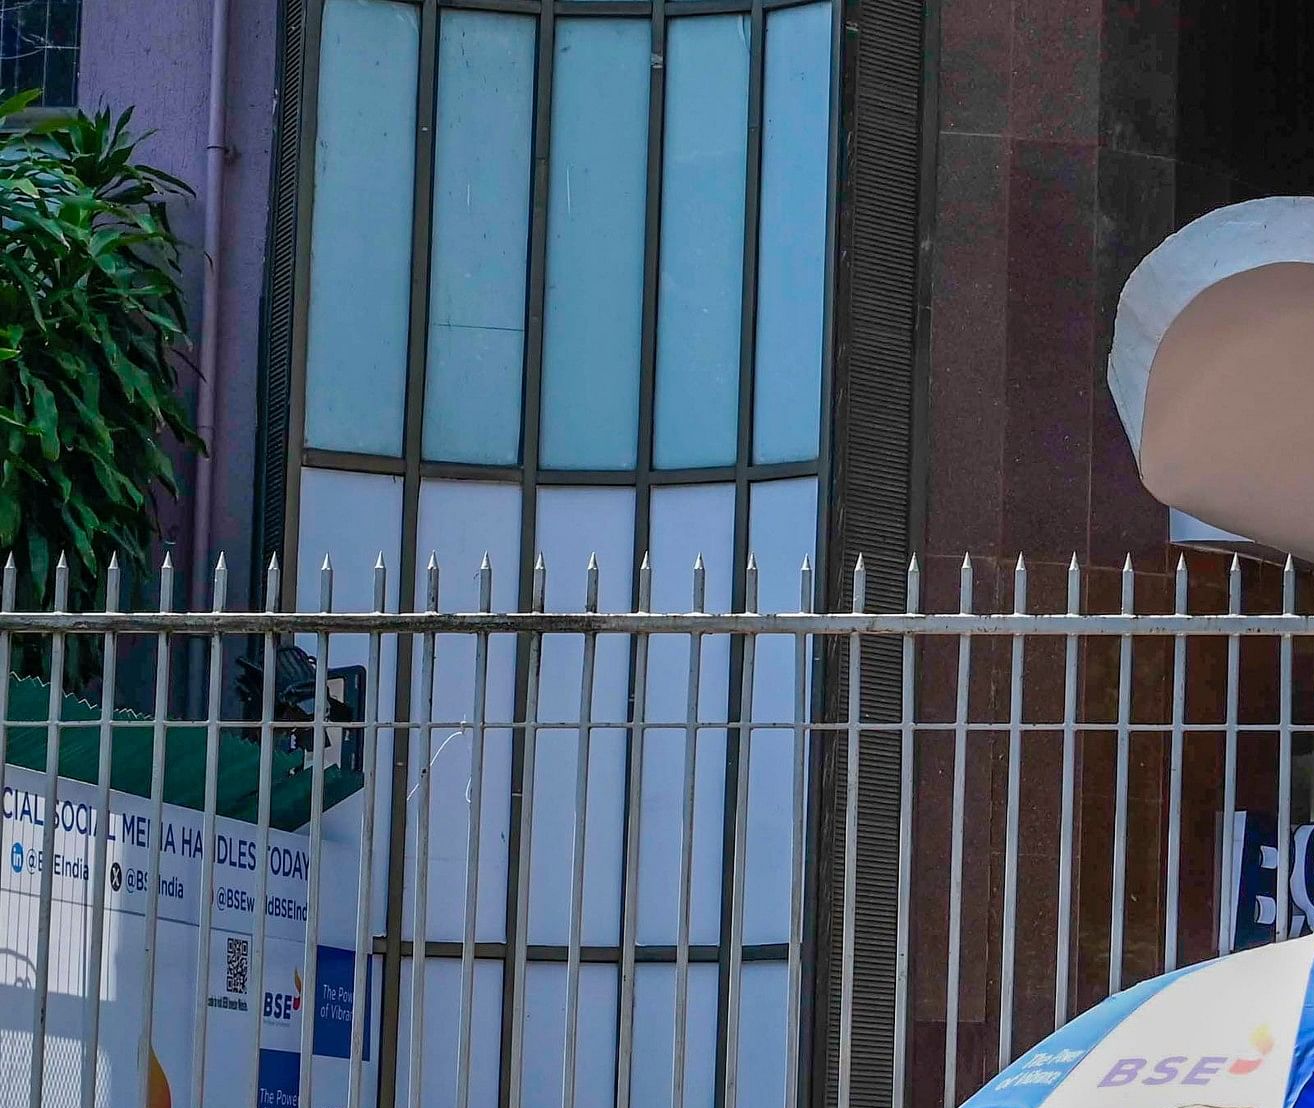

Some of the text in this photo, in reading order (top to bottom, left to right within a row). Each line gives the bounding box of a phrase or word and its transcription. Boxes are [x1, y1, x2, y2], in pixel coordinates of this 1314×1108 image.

[122, 812, 176, 855] MEIA
[181, 826, 257, 871] HADLES
[323, 983, 336, 1000] The
[263, 991, 293, 1020] BSE
[320, 1003, 329, 1019] of
[1097, 1055, 1229, 1089] BSE
[260, 1087, 275, 1104] The
